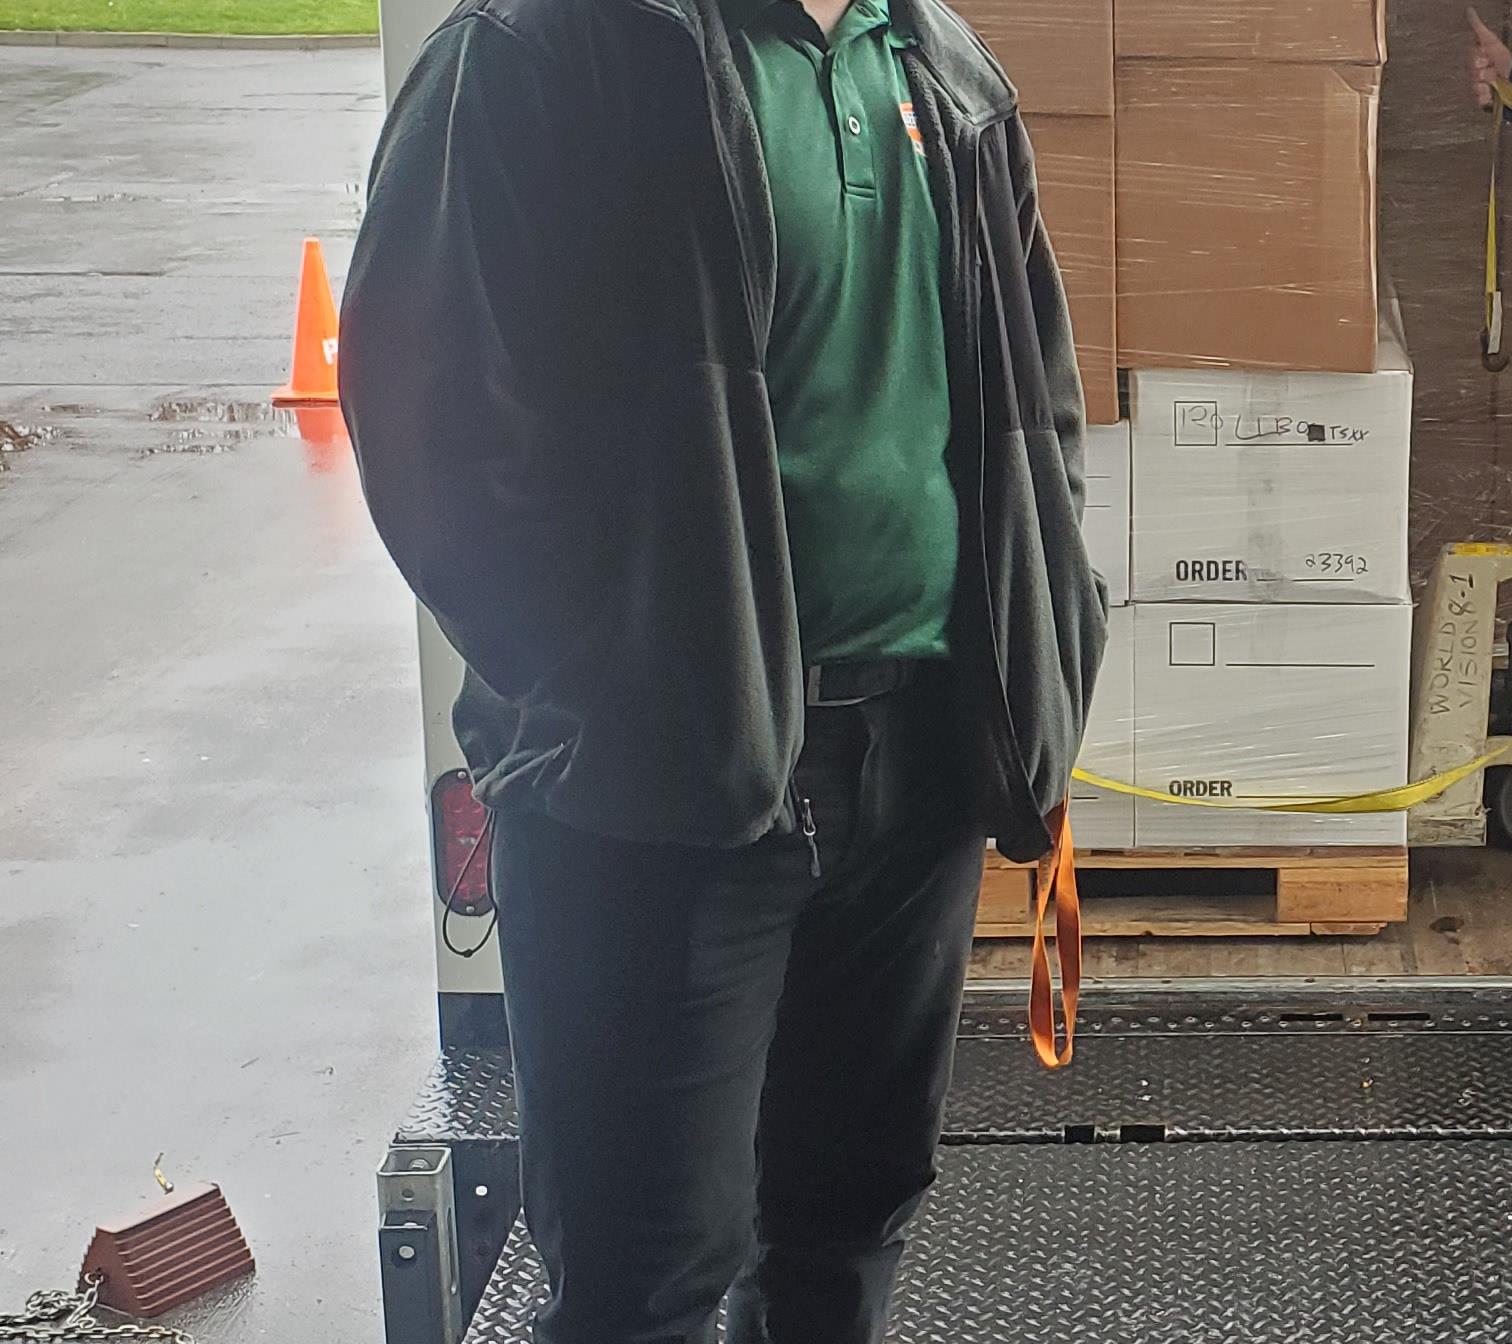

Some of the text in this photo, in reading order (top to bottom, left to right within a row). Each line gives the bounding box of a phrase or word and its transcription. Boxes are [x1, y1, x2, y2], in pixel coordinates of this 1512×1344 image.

[1175, 559, 1249, 582] ORDER
[1430, 621, 1457, 715] WORLD
[1455, 619, 1479, 709] VISION
[1168, 779, 1233, 797] ORDER
